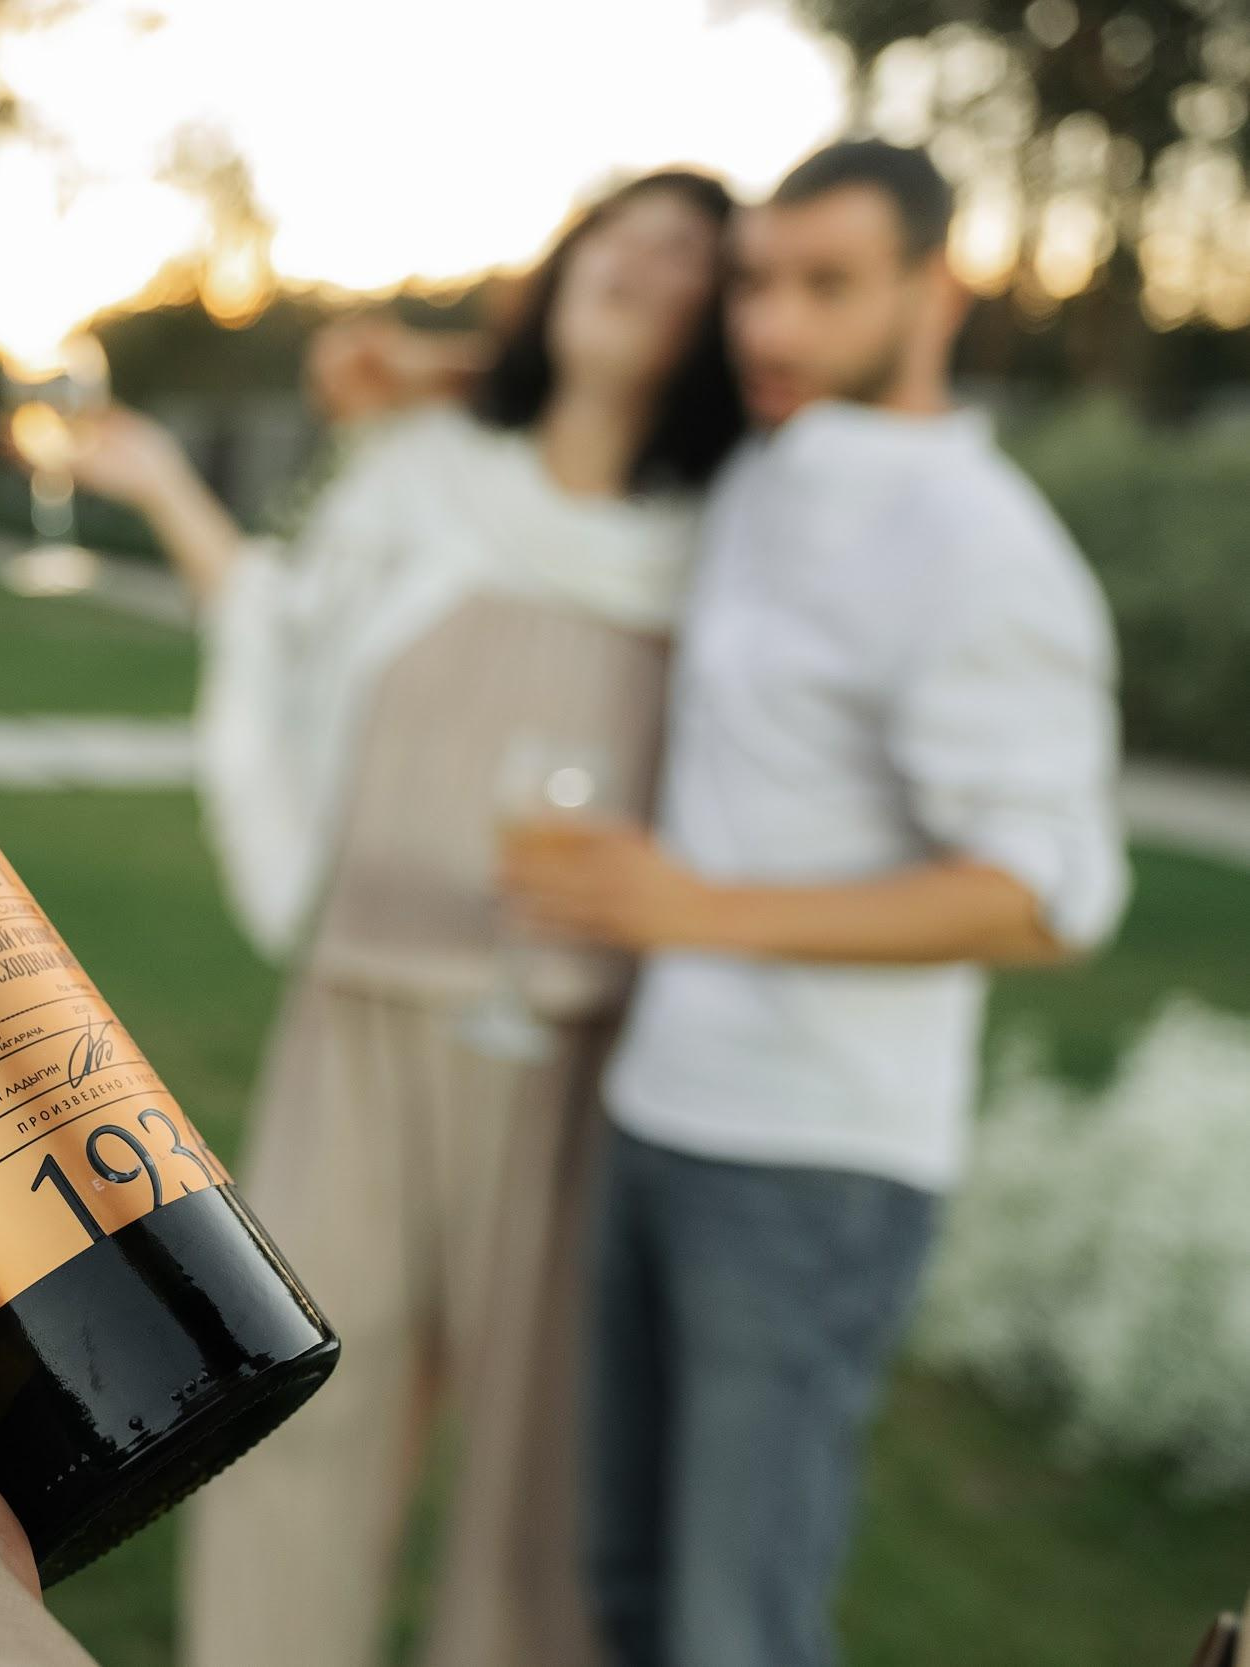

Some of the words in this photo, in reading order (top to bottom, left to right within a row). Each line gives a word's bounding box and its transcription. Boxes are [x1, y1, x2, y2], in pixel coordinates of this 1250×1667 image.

[5, 1063, 61, 1097] ЛАДЫГИН
[16, 1079, 123, 1134] ПРОИЗВЕДЕНО
[31, 1108, 230, 1244] 193
